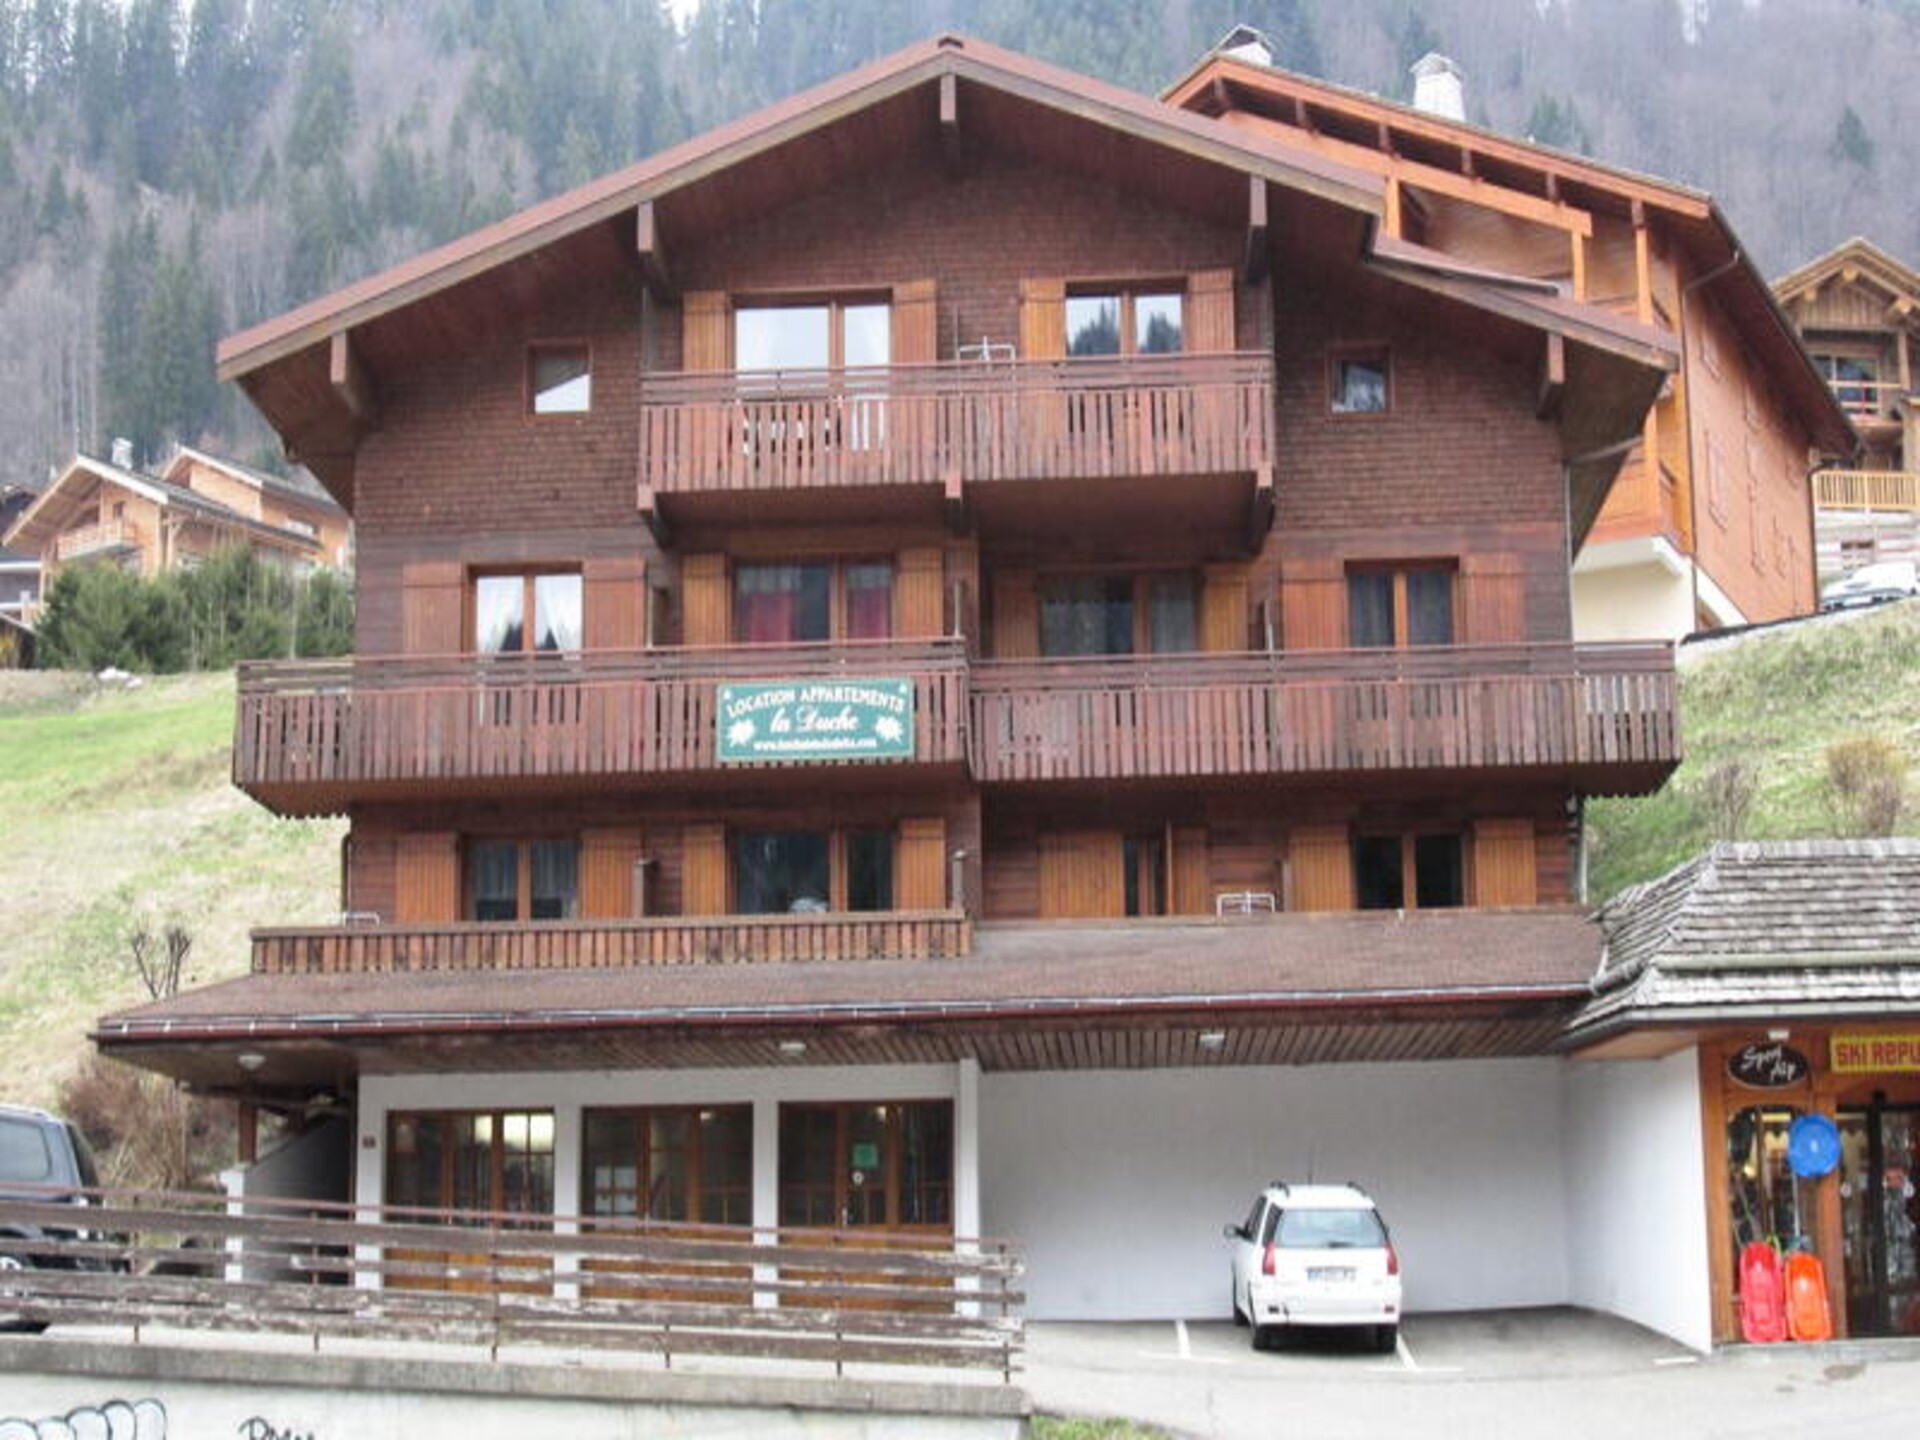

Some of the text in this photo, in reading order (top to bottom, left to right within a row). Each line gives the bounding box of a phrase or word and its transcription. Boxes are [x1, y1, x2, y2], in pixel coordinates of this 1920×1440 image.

[727, 686, 905, 717] LOCATION APPARTEMENTS
[1837, 1042, 1866, 1064] SKI
